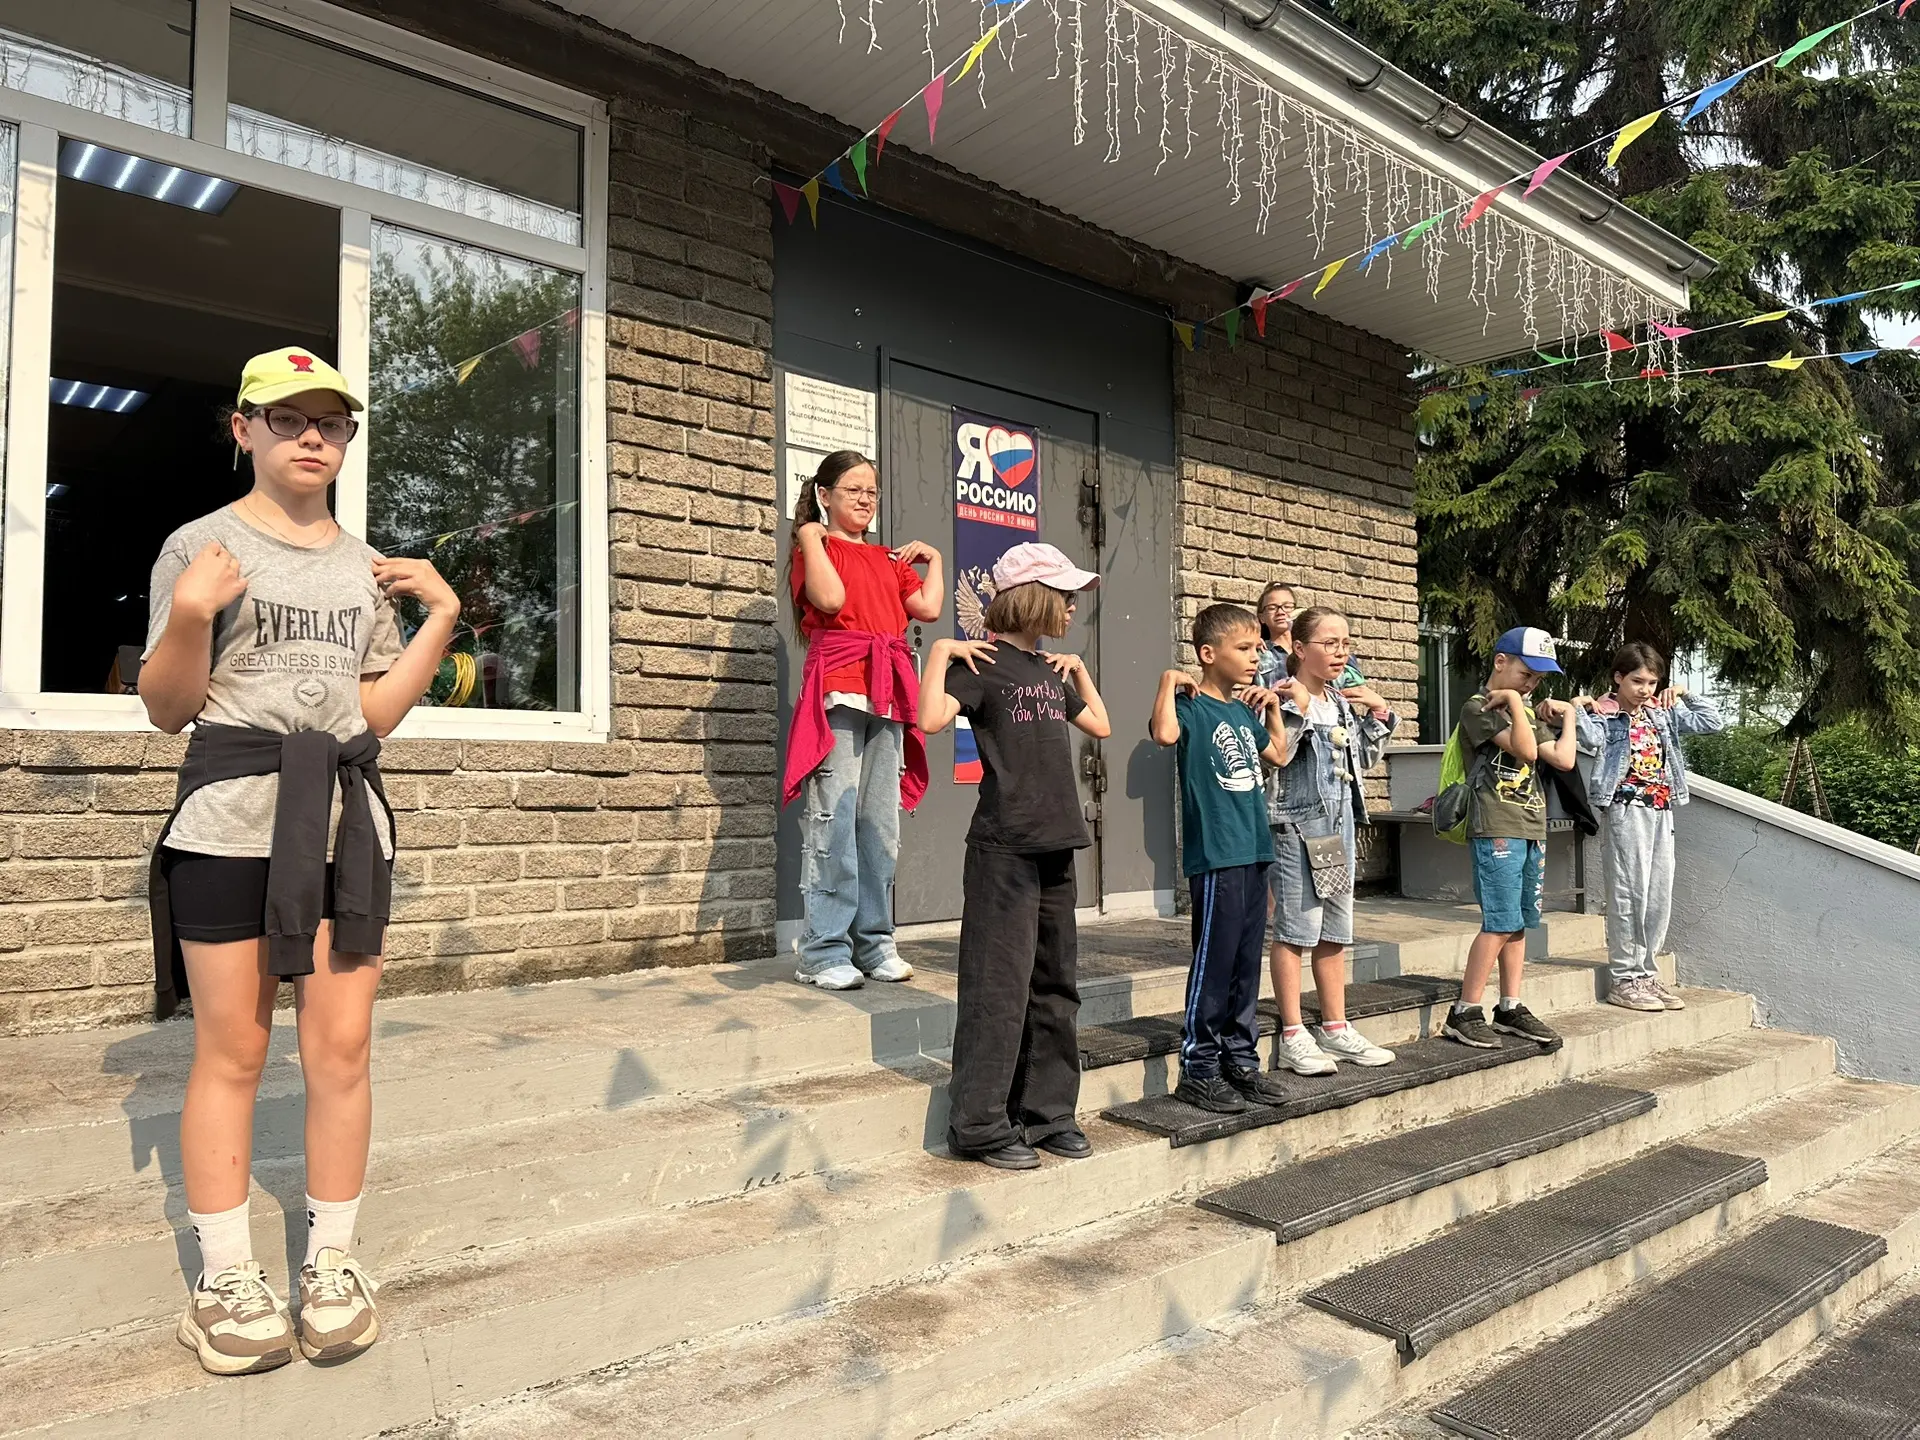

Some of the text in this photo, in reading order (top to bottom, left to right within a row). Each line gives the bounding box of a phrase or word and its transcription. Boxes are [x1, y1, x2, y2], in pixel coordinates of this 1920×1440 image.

[957, 422, 994, 484] Я
[956, 479, 1037, 515] РОССИЮ
[959, 506, 1036, 529] ДЕНЬ РОССИИ 12 ИЮНЯ
[252, 597, 362, 652] EVERLAST
[230, 651, 320, 668] GREATNESS
[324, 655, 337, 669] IS
[296, 668, 314, 676] NEW
[1005, 703, 1034, 723] You
